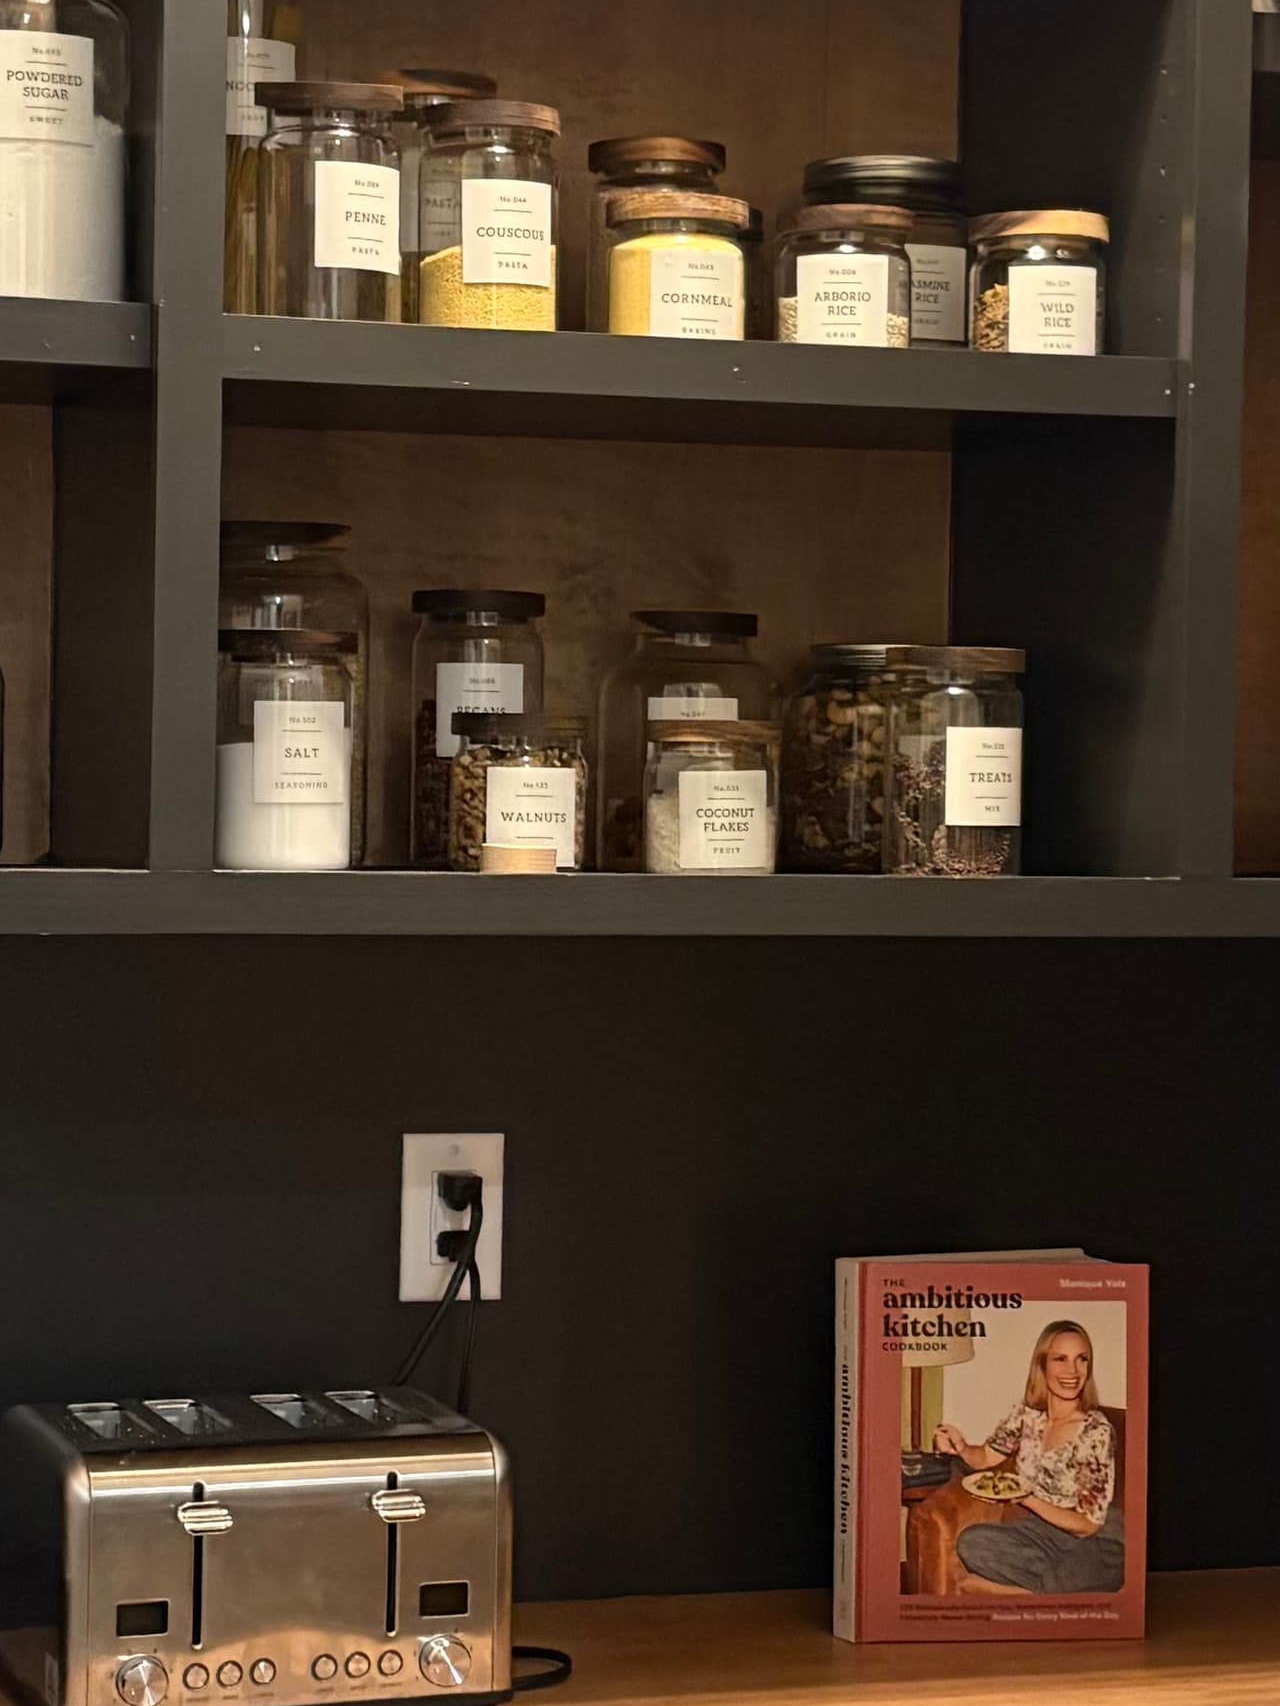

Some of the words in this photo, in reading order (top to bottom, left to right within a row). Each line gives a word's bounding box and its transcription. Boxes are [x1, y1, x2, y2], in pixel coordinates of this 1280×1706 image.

[6, 70, 83, 86] POWDERED
[23, 86, 69, 100] SUGAR
[345, 211, 387, 226] PENNE
[476, 227, 544, 241] COUSCOUS
[661, 293, 733, 308] CORNMEAL
[814, 291, 871, 302] ARBORIO
[827, 305, 857, 316] RICE
[1040, 302, 1075, 314] WILD
[1044, 317, 1072, 328] RICE
[284, 747, 320, 759] SALT
[968, 772, 1012, 783] TREATS
[500, 811, 568, 823] WALNUTS
[696, 808, 755, 819] COCONUT
[703, 822, 750, 832] FLAKES
[882, 1278, 906, 1287] THE
[882, 1285, 1024, 1309] ambitious
[882, 1313, 987, 1338] kitchen
[882, 1342, 948, 1352] COOKBOOK
